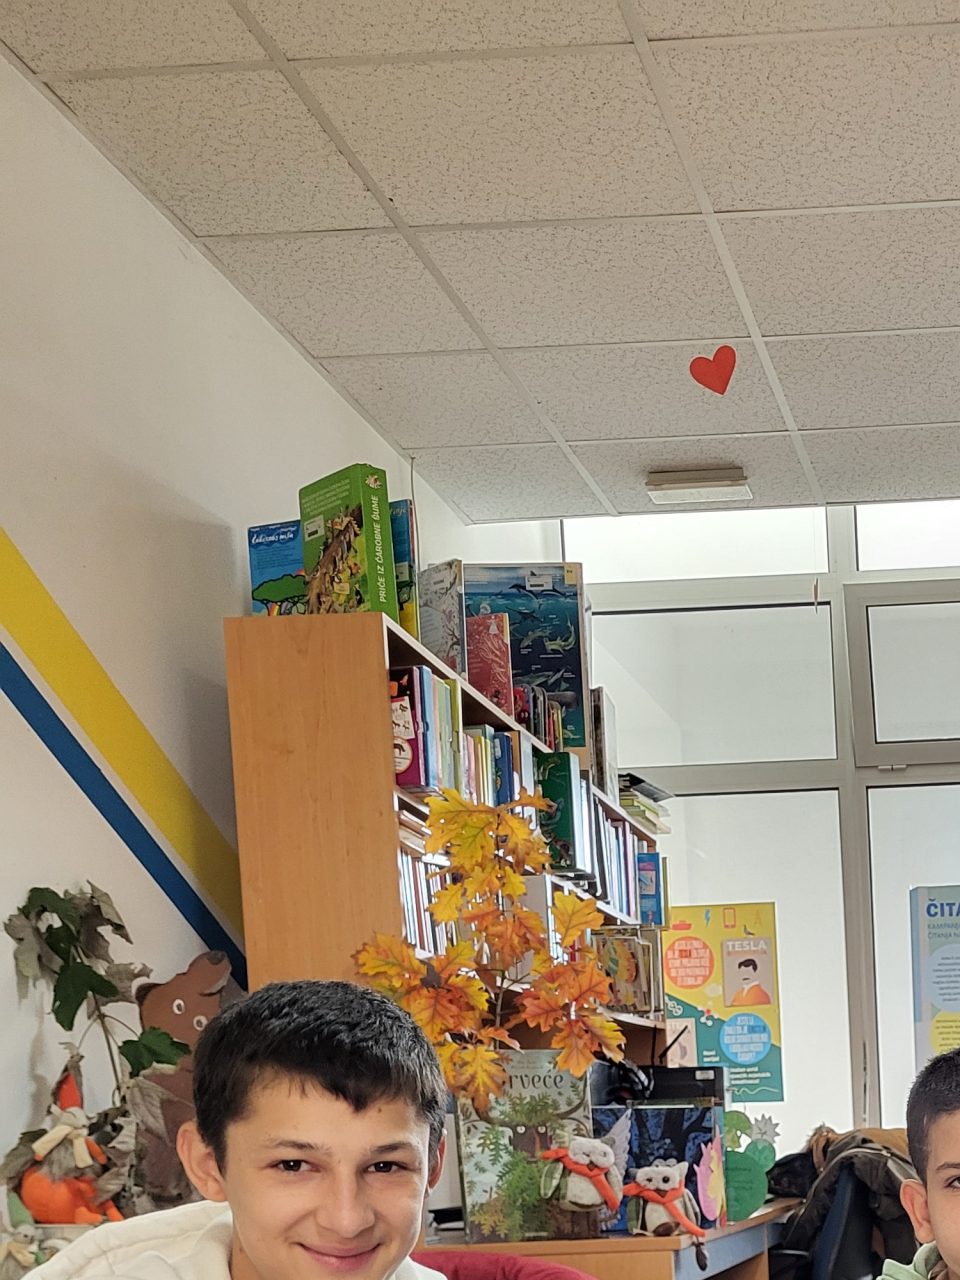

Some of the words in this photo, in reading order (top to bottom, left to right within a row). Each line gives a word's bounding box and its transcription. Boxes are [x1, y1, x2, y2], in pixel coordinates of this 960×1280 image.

[373, 522, 384, 563] ČAROBNE
[377, 564, 385, 574] IZ
[376, 576, 387, 603] PRIČE
[726, 939, 768, 951] TESLA
[509, 1069, 564, 1089] rveće
